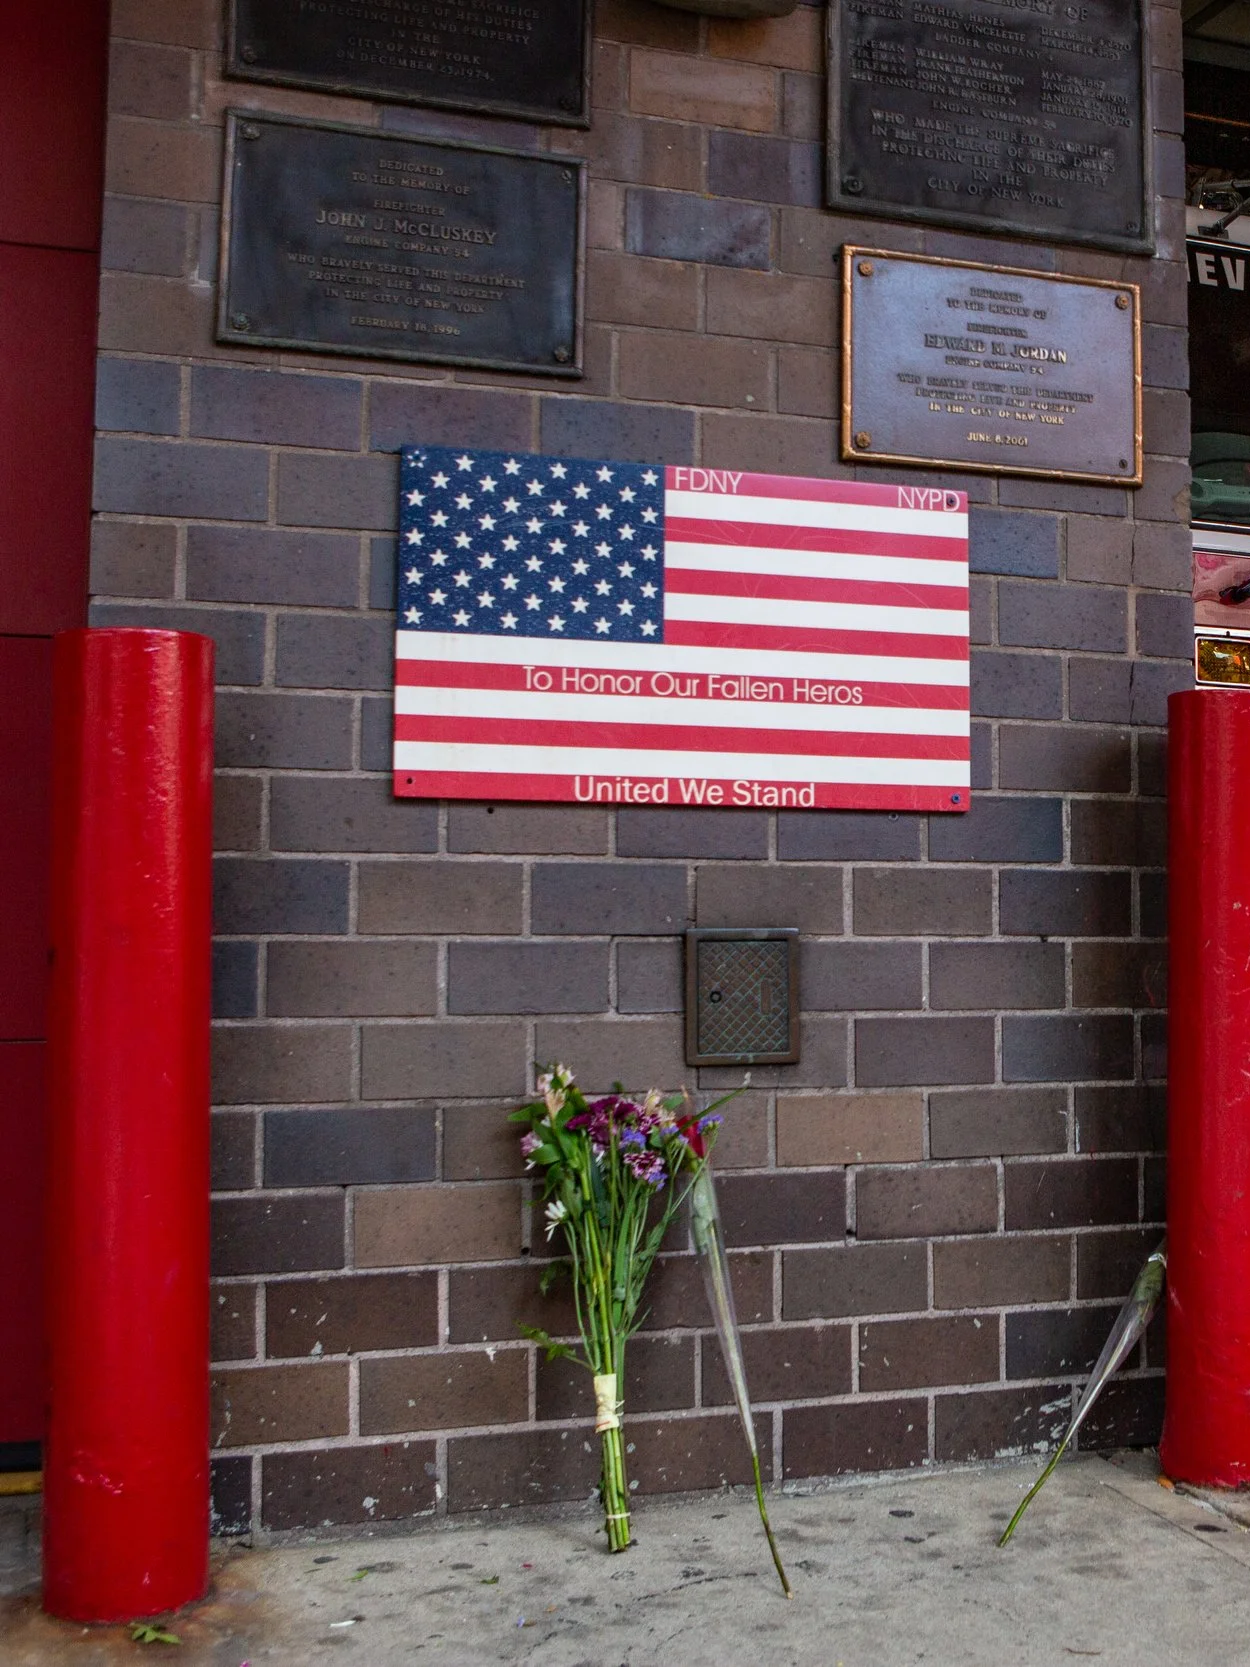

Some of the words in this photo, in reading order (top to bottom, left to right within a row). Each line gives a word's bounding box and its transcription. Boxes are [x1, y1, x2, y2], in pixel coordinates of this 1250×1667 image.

[300, 0, 387, 21] PROTECTING
[394, 14, 423, 27] LIFE
[432, 21, 456, 32] AND
[463, 26, 529, 44] PROPERTY
[434, 7, 450, 16] OF
[484, 15, 532, 30] DUTIES
[848, 1, 903, 20] FIREMAN
[912, 13, 958, 30] EDWARD
[964, 22, 1025, 42] VINCELETTE
[348, 37, 380, 49] CITY
[386, 41, 403, 52] OF
[410, 46, 437, 57] NEW
[445, 51, 480, 64] YORK
[414, 31, 439, 44] THE
[935, 32, 980, 48] LADDER
[986, 41, 1041, 60] COMPANY
[360, 51, 433, 70] DECEMBER
[915, 47, 965, 64] WILLIAM
[970, 56, 1004, 71] WRAY
[915, 57, 950, 72] FRANK
[1041, 80, 1086, 97] JANUARY
[916, 68, 946, 83] JOHN
[918, 80, 944, 94] JOHN
[932, 99, 975, 115] ENGINE
[980, 108, 1037, 127] COMPANY
[871, 110, 904, 125] WHO
[913, 117, 950, 132] MADE
[987, 128, 1044, 148] SUPREME
[871, 124, 886, 137] IN
[923, 132, 1000, 155] DISCHARGE
[1007, 145, 1023, 158] OF
[379, 161, 443, 176] DEDICATED
[972, 155, 999, 169] LIFE
[1008, 160, 1035, 175] AND
[1041, 164, 1107, 187] PROPERTY
[972, 168, 989, 181] IN
[999, 173, 1021, 187] THE
[352, 171, 366, 182] TO
[372, 174, 395, 186] THE
[400, 177, 450, 193] MEMORY
[454, 184, 470, 196] OF
[927, 176, 960, 193] CITY
[967, 183, 982, 196] OF
[990, 186, 1021, 202] NEW
[1028, 192, 1065, 208] YORK
[373, 199, 444, 217] FIREFIGHTER
[315, 209, 366, 229] JOHN
[373, 217, 385, 232] J.
[393, 219, 496, 245] McCLUSKEY
[345, 235, 388, 248] ENGINE
[395, 240, 448, 256] COMPANY
[287, 253, 314, 264] WHO
[321, 256, 376, 272] BRAVELY
[380, 263, 419, 276] SERVED
[424, 269, 448, 280] THIS
[454, 272, 524, 289] DEPARTMENT
[308, 270, 381, 287] PROTECTING
[387, 279, 411, 290] LIFE
[417, 283, 440, 294] AND
[446, 286, 503, 301] PROPERTY
[325, 287, 338, 297] IN
[344, 289, 365, 301] THE
[373, 293, 399, 304] CITY
[405, 296, 420, 307] OF
[424, 299, 450, 310] NEW
[456, 302, 484, 314] YORK
[351, 315, 409, 331] FEBRUARY
[924, 333, 985, 353] EDWARD
[1010, 343, 1066, 363] JORDAN
[929, 401, 940, 411] IN
[946, 403, 964, 414] THE
[970, 406, 991, 417] CITY
[998, 409, 1011, 419] OF
[1014, 411, 1035, 422] NEW
[1040, 414, 1064, 425] YORK
[1005, 396, 1024, 407] AND
[967, 431, 991, 442] JUNE
[674, 466, 744, 494] FDNY
[897, 485, 961, 512] NYPD
[523, 666, 552, 691] To
[561, 668, 643, 694] Honor
[650, 672, 700, 697] Our
[707, 675, 785, 701] Fallen
[792, 679, 863, 705] Heros
[573, 775, 670, 804] United
[679, 779, 724, 805] We
[732, 780, 816, 808] Stand
